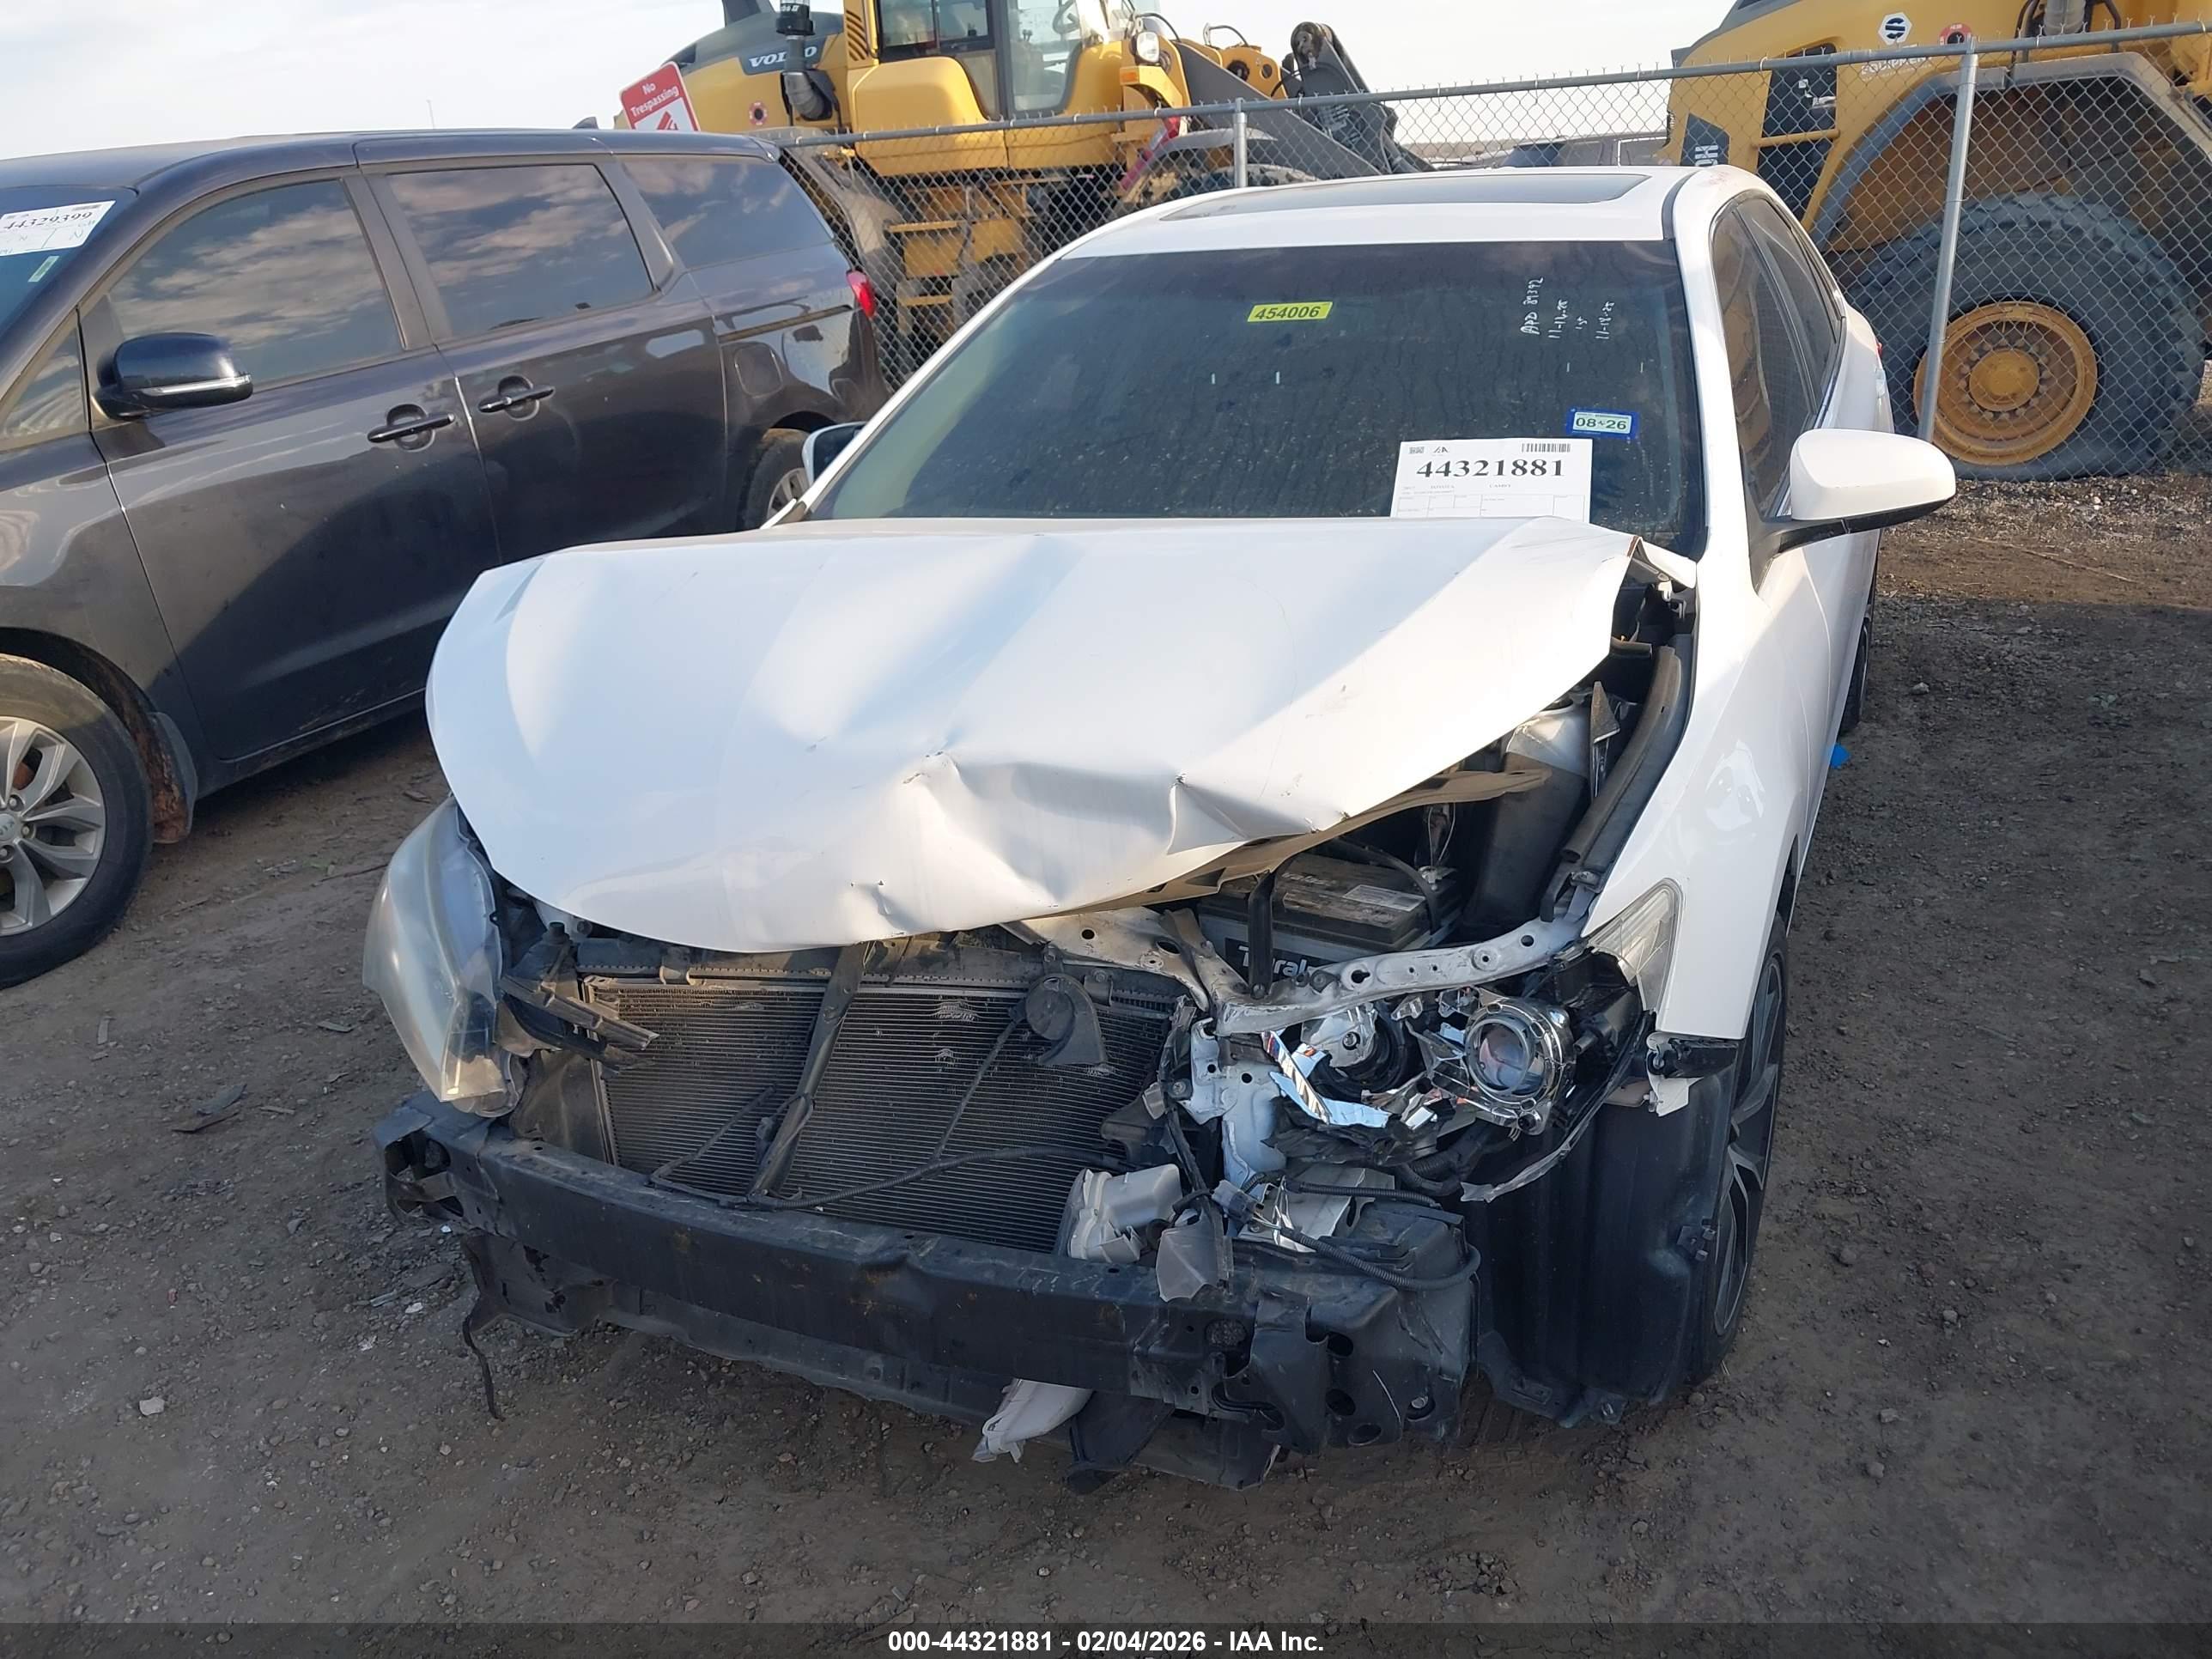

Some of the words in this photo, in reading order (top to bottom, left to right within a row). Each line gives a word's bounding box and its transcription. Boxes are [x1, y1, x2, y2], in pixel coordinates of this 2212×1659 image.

[641, 82, 657, 95] No
[630, 86, 680, 117] Trespassing
[1255, 306, 1322, 319] 454006
[1576, 417, 1596, 428] 08
[1605, 419, 1627, 430] 26
[1416, 459, 1565, 477] 44321881
